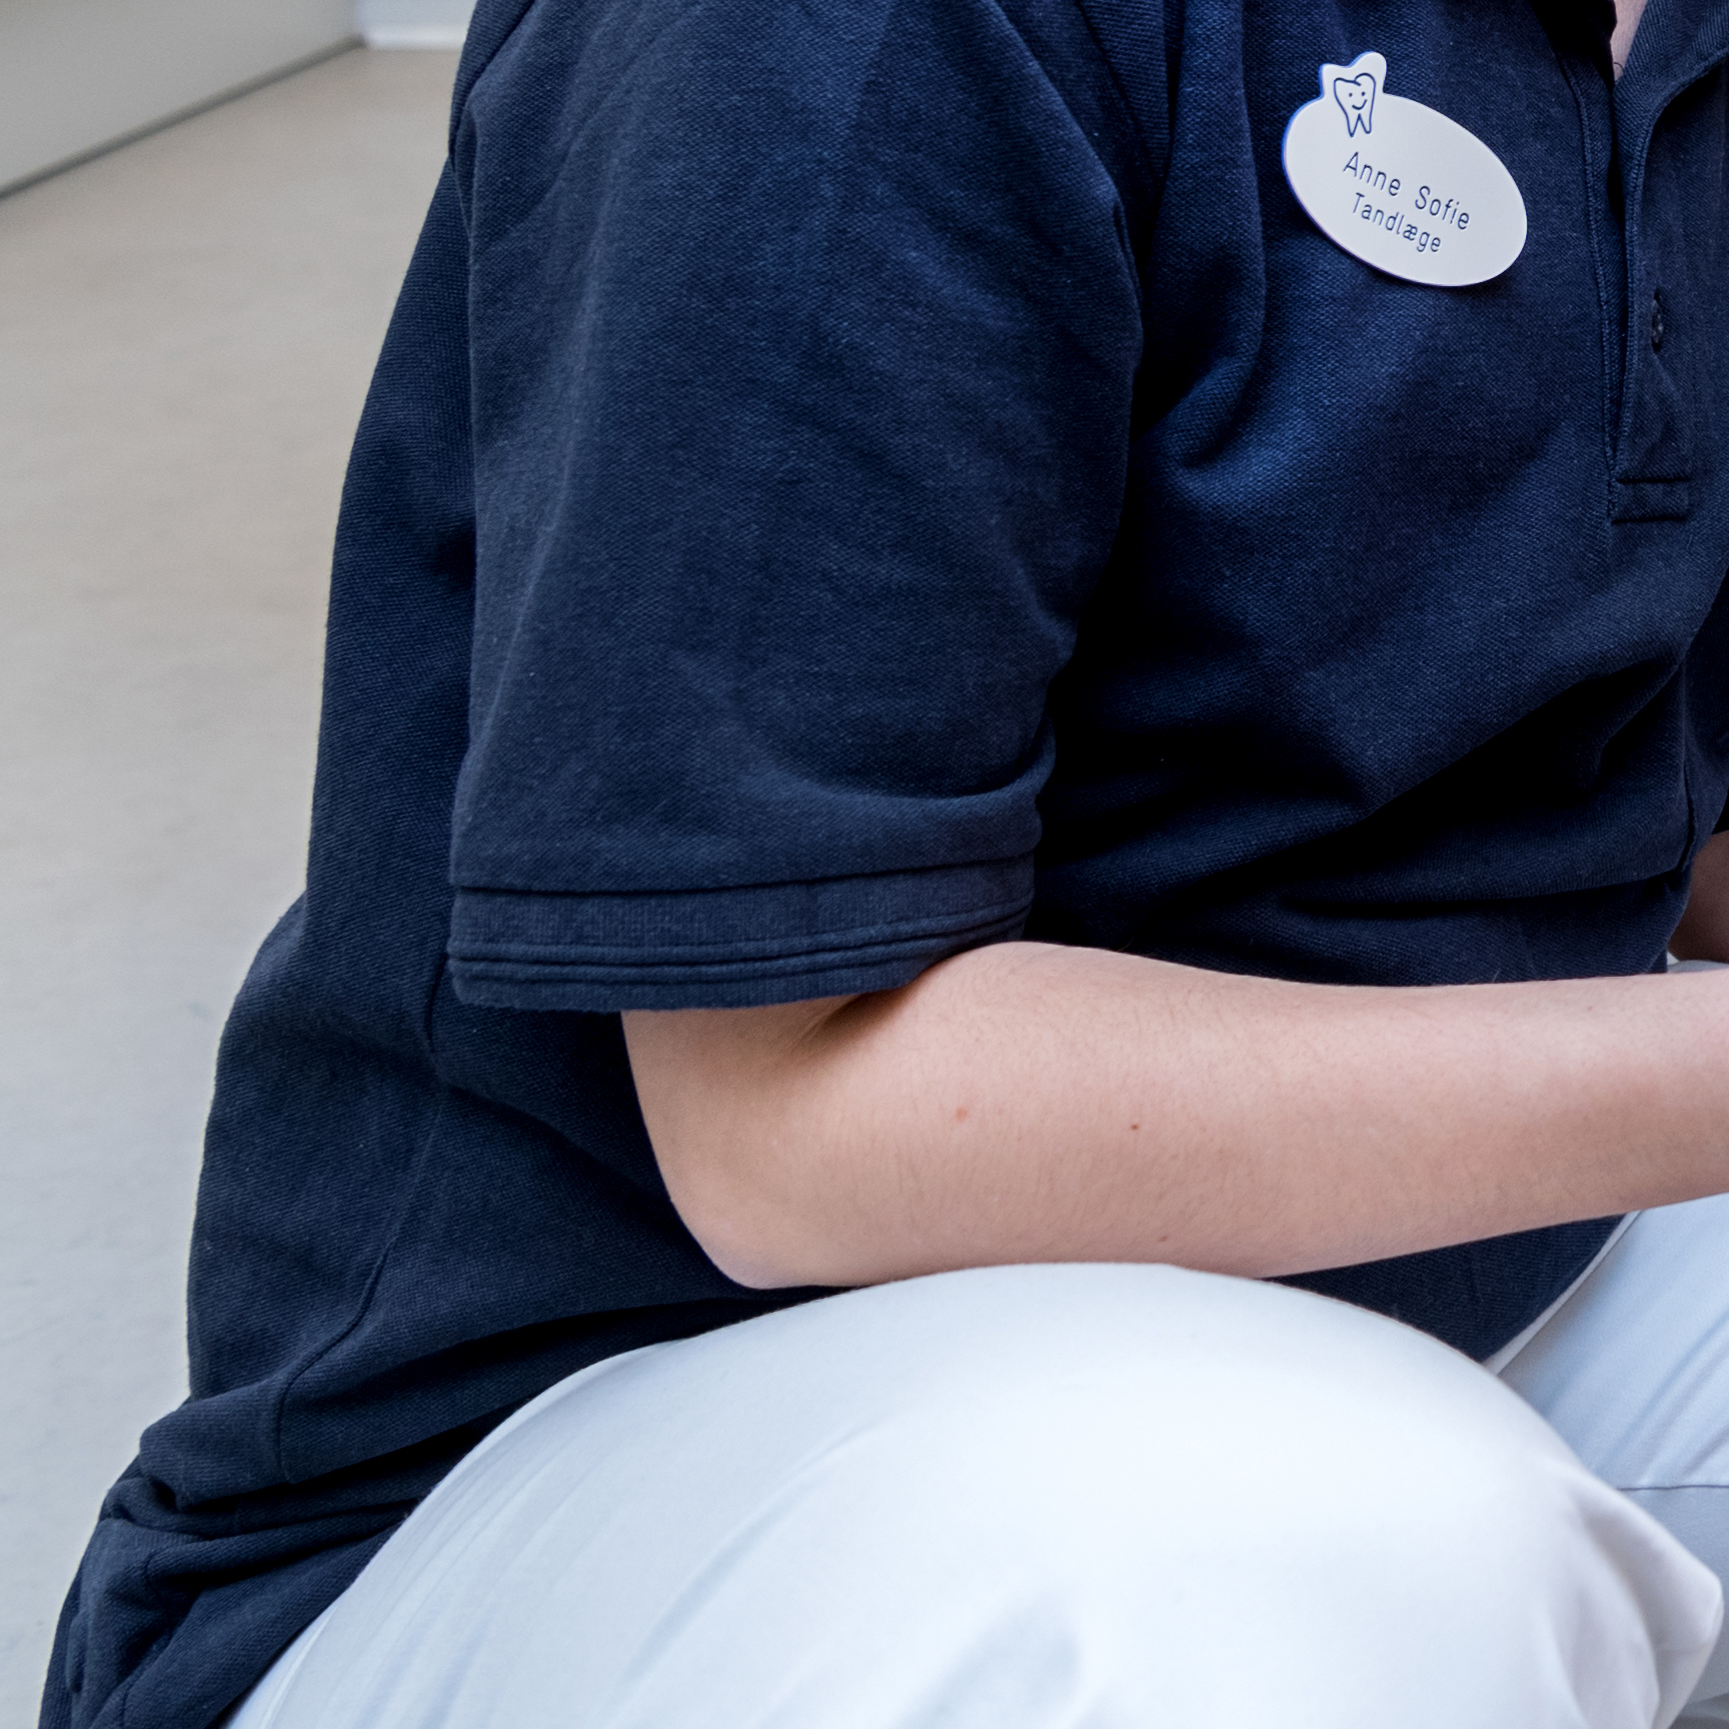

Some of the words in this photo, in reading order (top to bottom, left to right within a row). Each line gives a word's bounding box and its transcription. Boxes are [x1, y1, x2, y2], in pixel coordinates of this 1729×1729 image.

[1343, 151, 1401, 196] Anne
[1414, 185, 1470, 230] Sofie
[1353, 192, 1442, 253] Tandlæge
